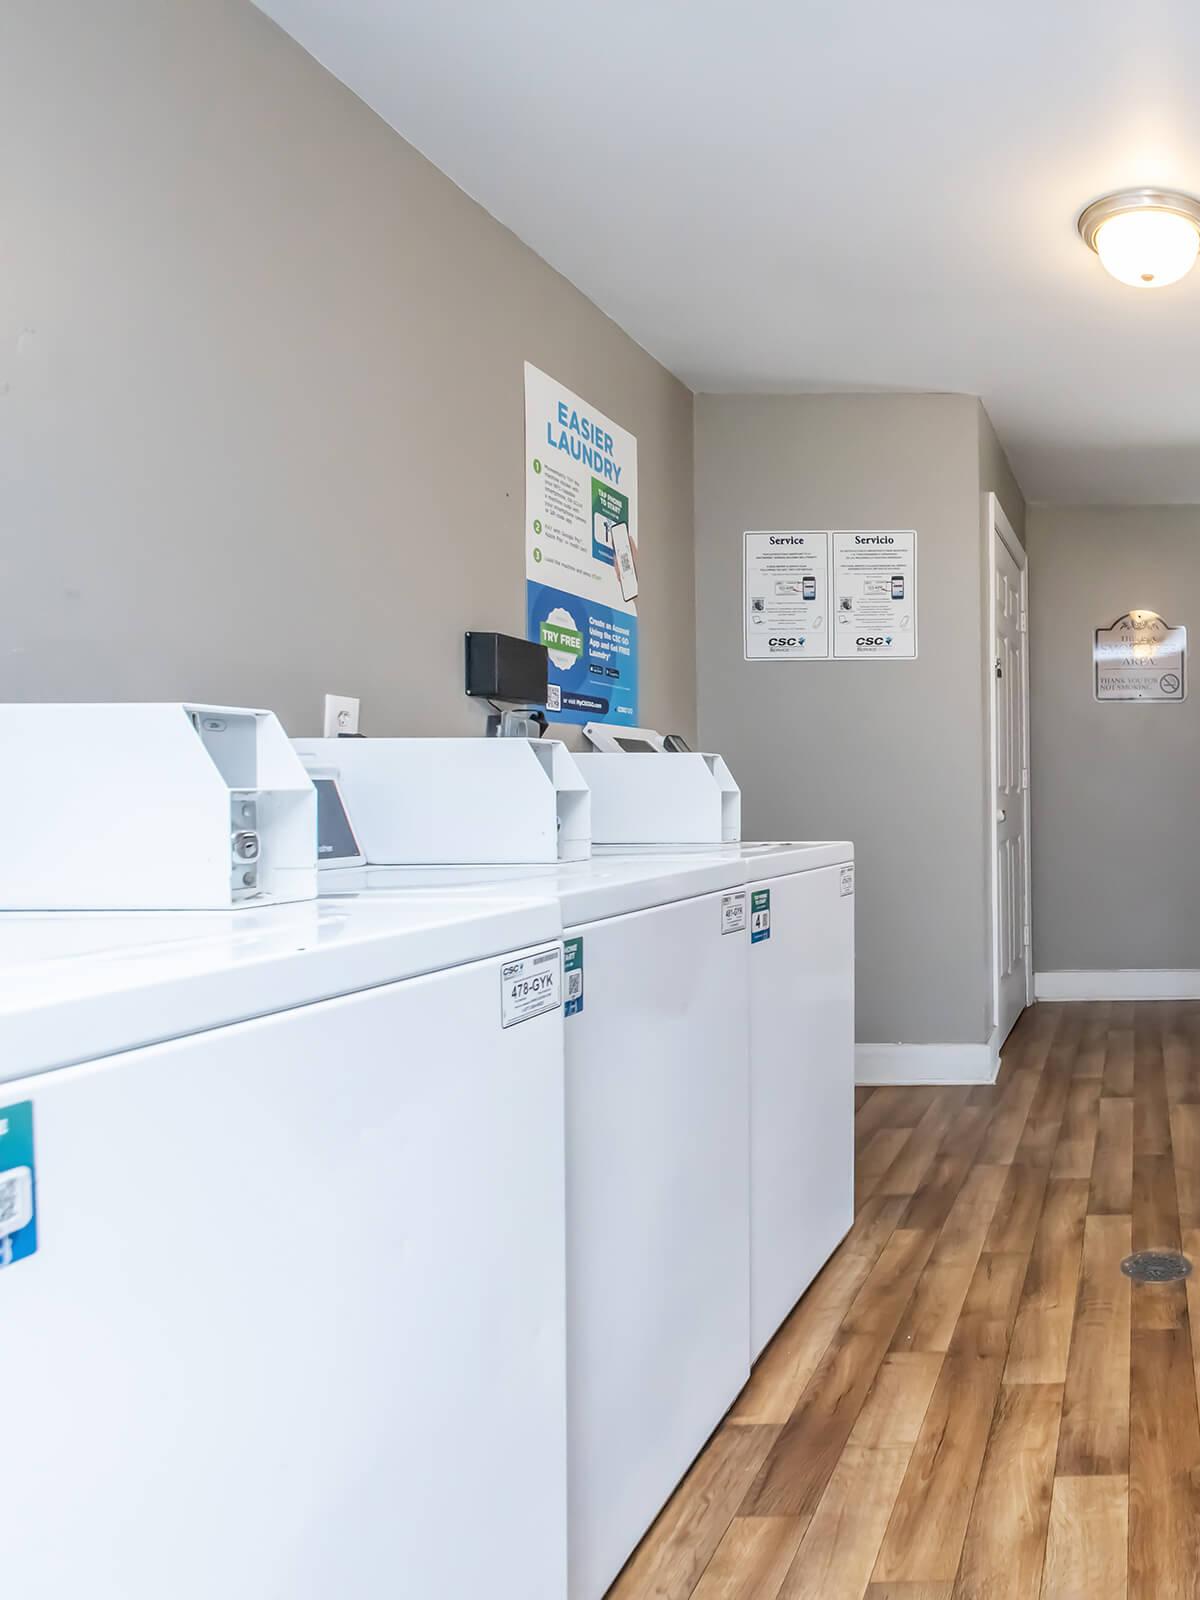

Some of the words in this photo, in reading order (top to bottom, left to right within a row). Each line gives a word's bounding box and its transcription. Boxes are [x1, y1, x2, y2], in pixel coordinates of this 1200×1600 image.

[558, 401, 614, 457] EASIER
[547, 422, 622, 485] LAUNDRY
[770, 536, 804, 545] Service
[855, 535, 894, 545] Servicio
[542, 629, 559, 643] TRY
[560, 634, 581, 649] FREE
[768, 637, 796, 646] CSC
[856, 636, 883, 646] CSC
[755, 913, 760, 929] 4
[511, 973, 553, 998] 478-GYK
